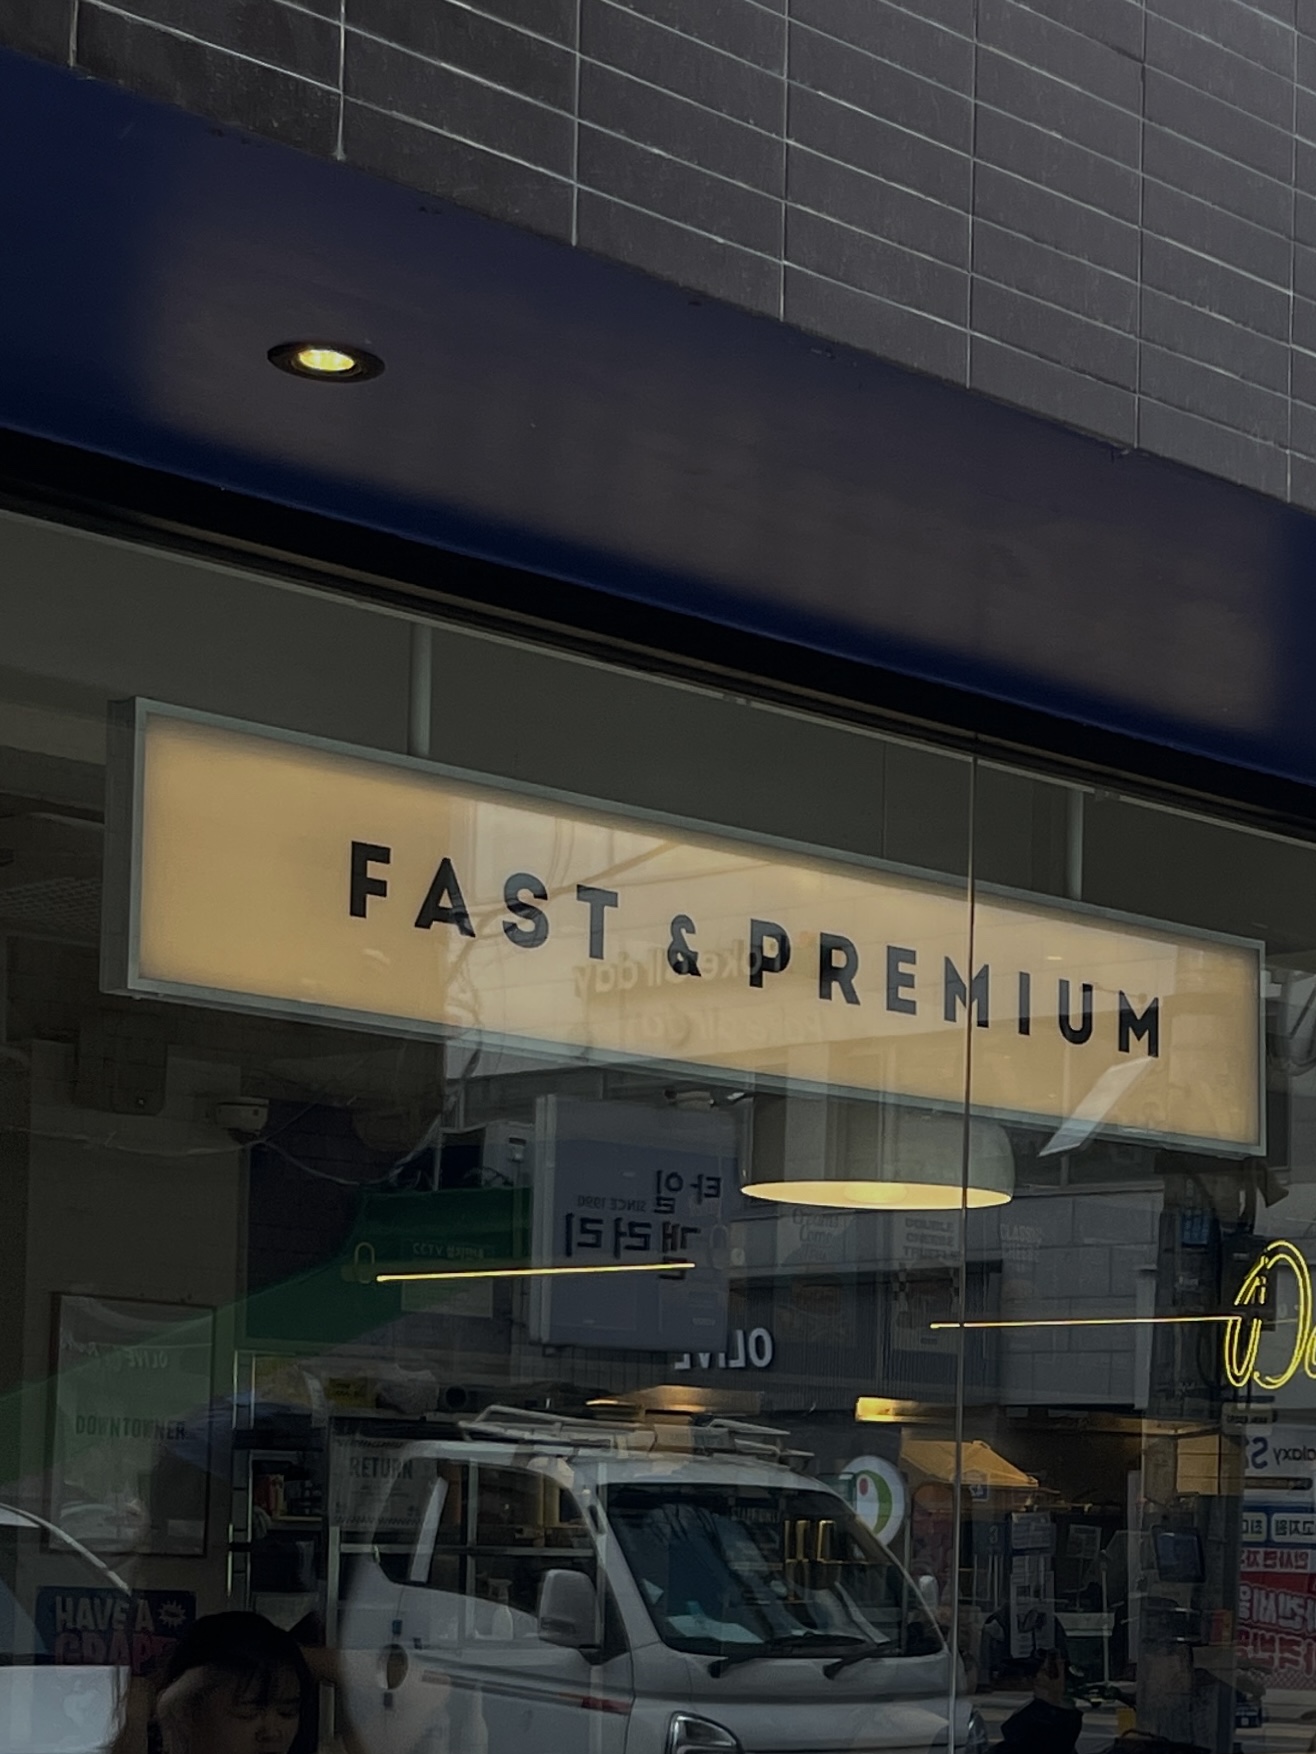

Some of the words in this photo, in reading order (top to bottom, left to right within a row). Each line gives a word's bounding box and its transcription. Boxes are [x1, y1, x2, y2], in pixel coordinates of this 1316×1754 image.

[349, 840, 620, 960] FAST
[665, 914, 702, 977] &
[748, 918, 1160, 1058] PREMIUM
[75, 1414, 187, 1442] DOWNTOWNER
[349, 1456, 413, 1480] RETURN
[55, 1595, 130, 1632] HAVE
[135, 1598, 155, 1632] A
